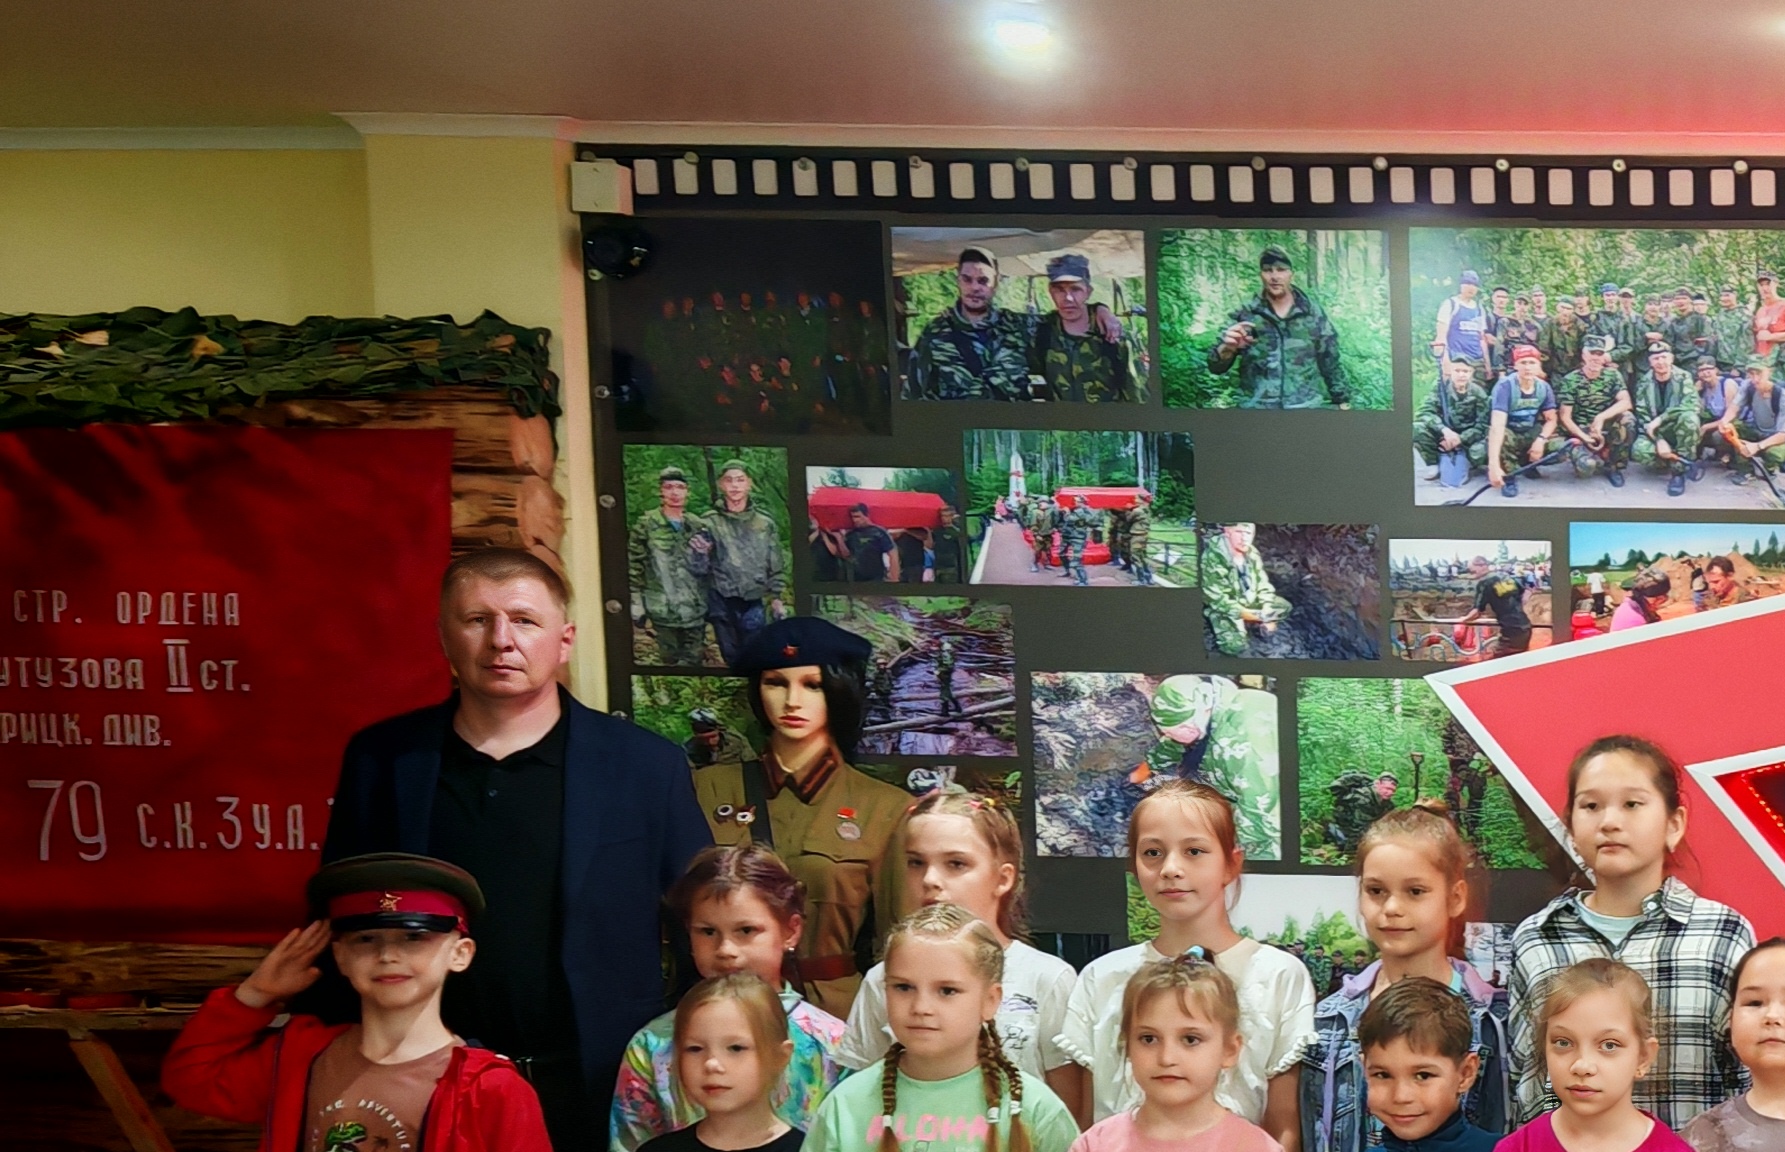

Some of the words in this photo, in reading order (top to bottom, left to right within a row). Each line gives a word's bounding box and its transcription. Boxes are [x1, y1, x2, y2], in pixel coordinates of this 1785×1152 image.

[13, 589, 82, 624] СТР.
[116, 591, 241, 626] ОРДЕНА
[200, 659, 251, 691] СТ.
[103, 714, 171, 747] ДИВ.
[27, 779, 107, 861] 79
